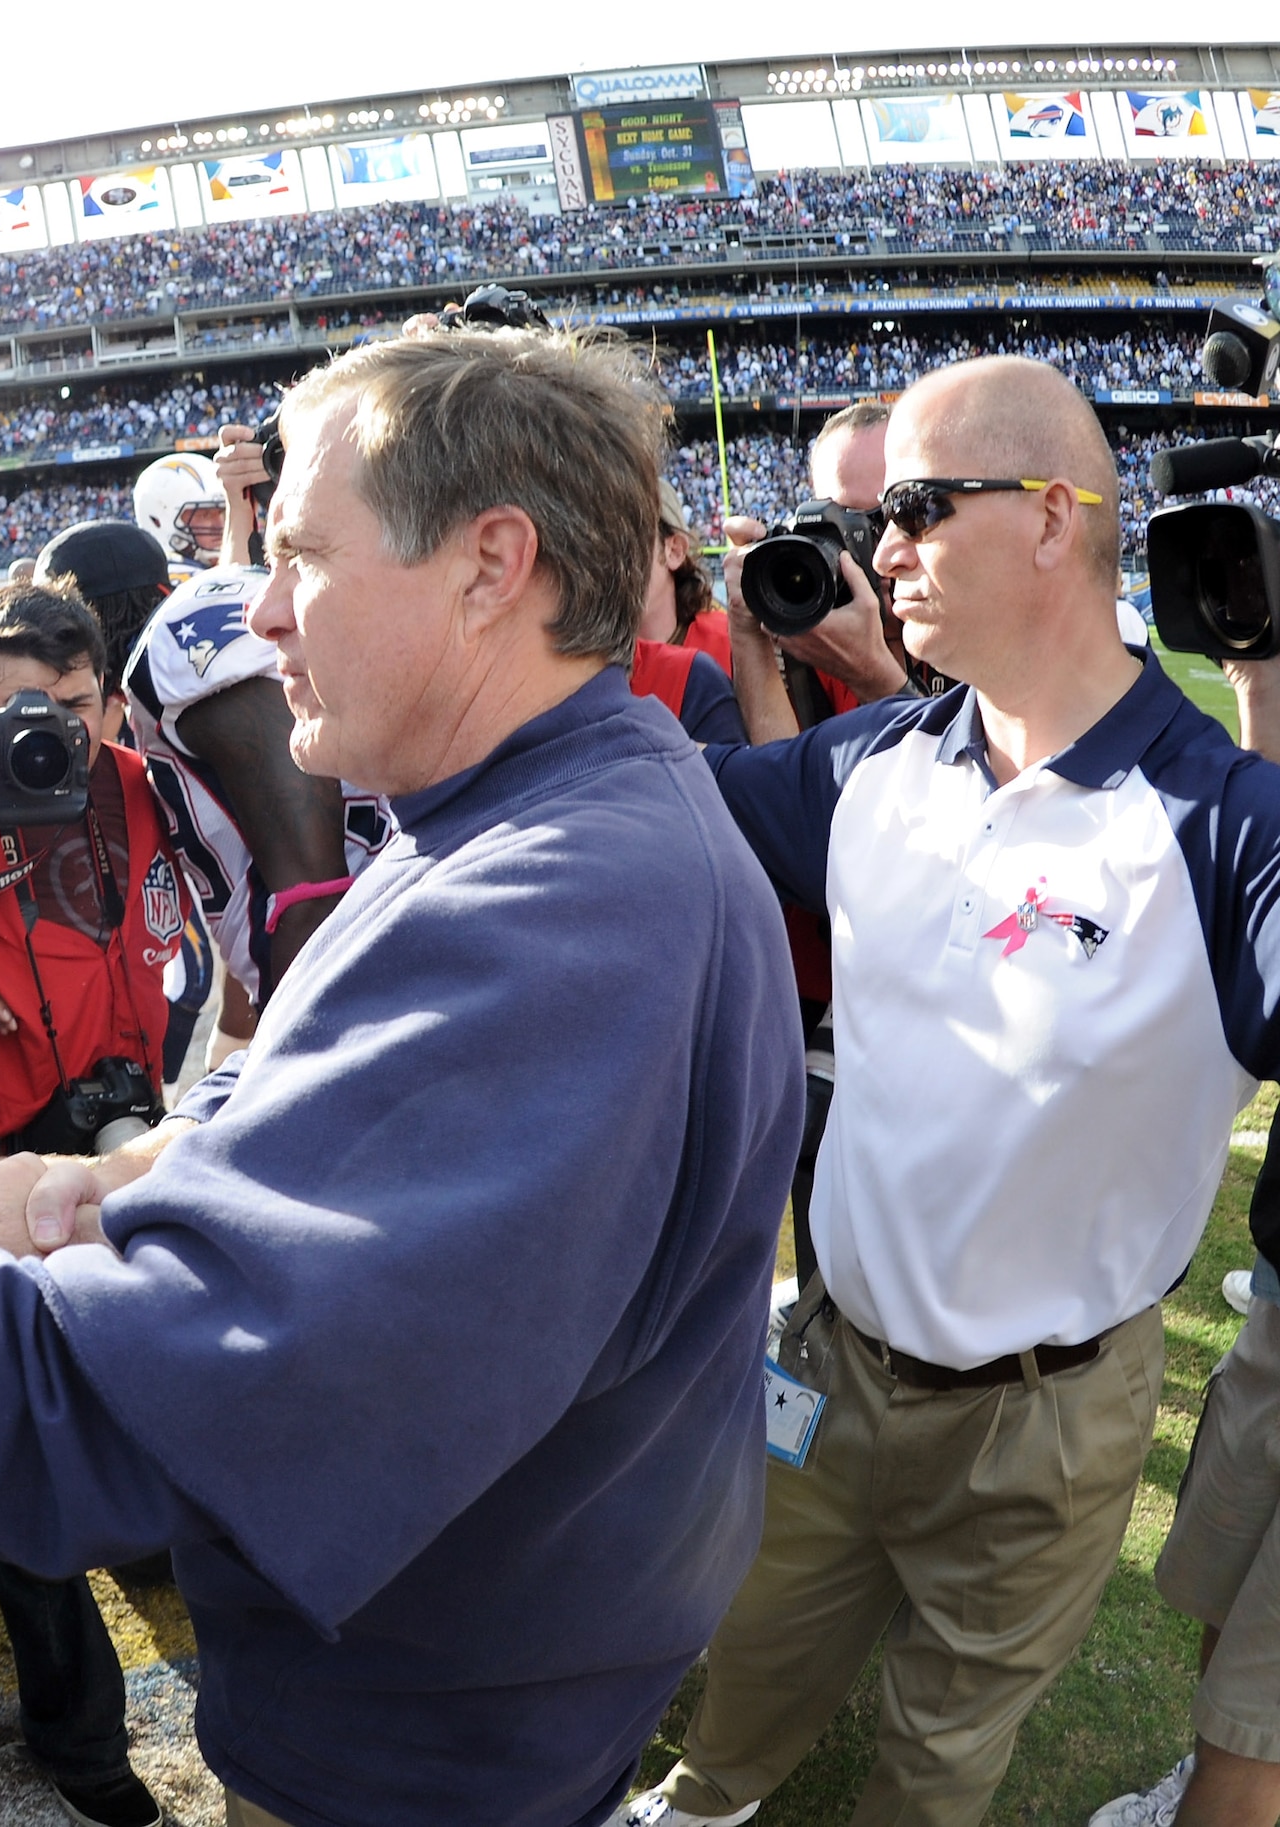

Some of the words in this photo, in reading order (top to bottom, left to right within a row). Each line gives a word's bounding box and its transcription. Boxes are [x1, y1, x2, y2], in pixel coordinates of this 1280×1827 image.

[577, 73, 702, 103] QUALCOMM
[621, 116, 647, 127] GOOD
[652, 113, 684, 125] NIGHT
[617, 132, 638, 145] NEXT
[641, 130, 665, 142] HOME
[556, 121, 580, 205] SYCUAN
[1024, 298, 1054, 308] LANCE
[1055, 298, 1100, 308] ALWORTH
[1155, 299, 1177, 308] RON
[1179, 299, 1196, 308] MIX
[1110, 391, 1160, 404] GEICO
[72, 446, 122, 462] GEICO
[797, 514, 822, 523] Canon
[21, 705, 48, 715] Canon
[1, 834, 19, 866] EO
[148, 890, 177, 930] NFL
